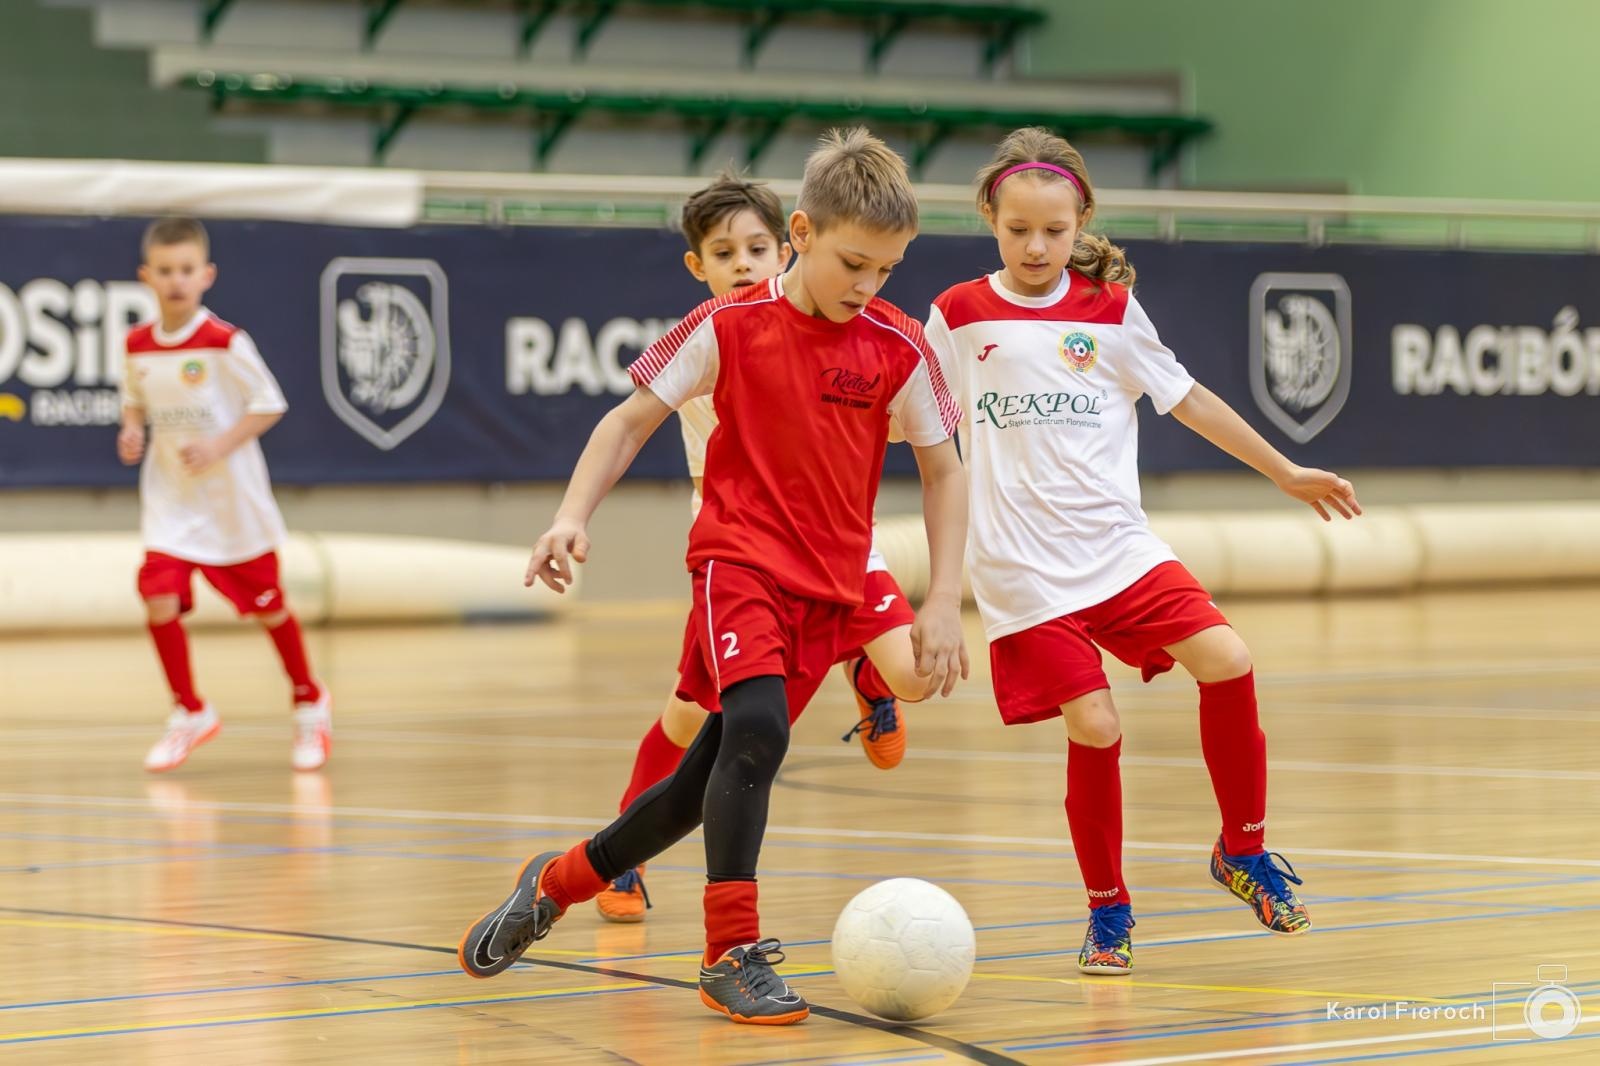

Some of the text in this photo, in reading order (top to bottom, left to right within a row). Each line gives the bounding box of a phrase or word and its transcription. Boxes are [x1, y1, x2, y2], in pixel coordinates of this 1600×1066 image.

[505, 316, 683, 396] RAC
[975, 391, 1102, 429] REKPOL
[1033, 417, 1065, 425] Centrum
[721, 631, 740, 660] 2
